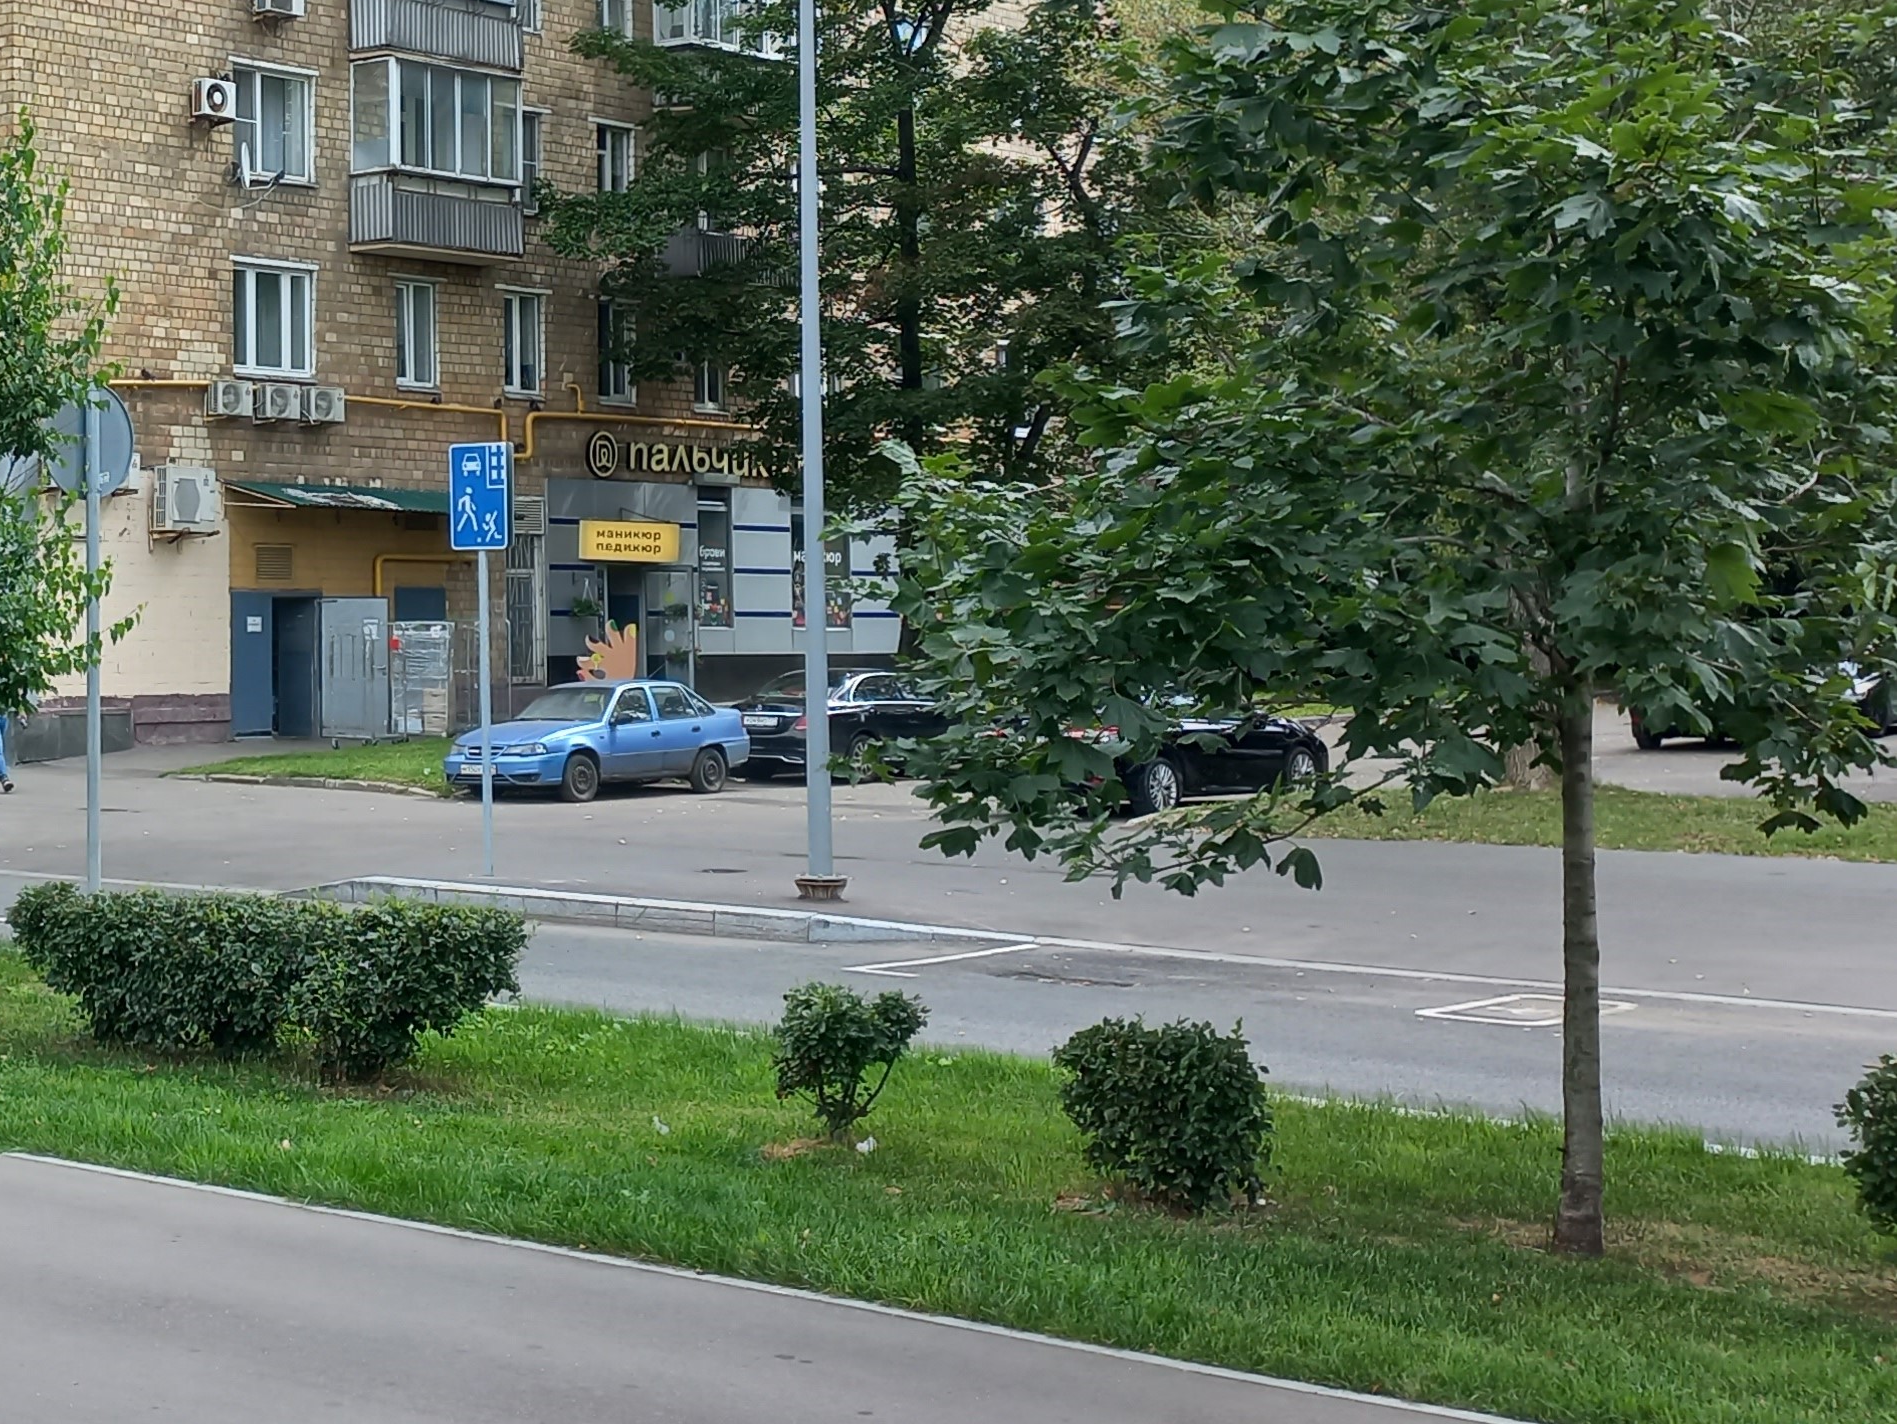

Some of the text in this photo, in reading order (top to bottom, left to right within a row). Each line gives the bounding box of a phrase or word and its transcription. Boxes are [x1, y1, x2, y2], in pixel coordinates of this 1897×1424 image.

[596, 530, 662, 543] маникюр
[596, 542, 662, 556] педикюр
[699, 544, 726, 561] брови
[793, 550, 842, 567] макюр
